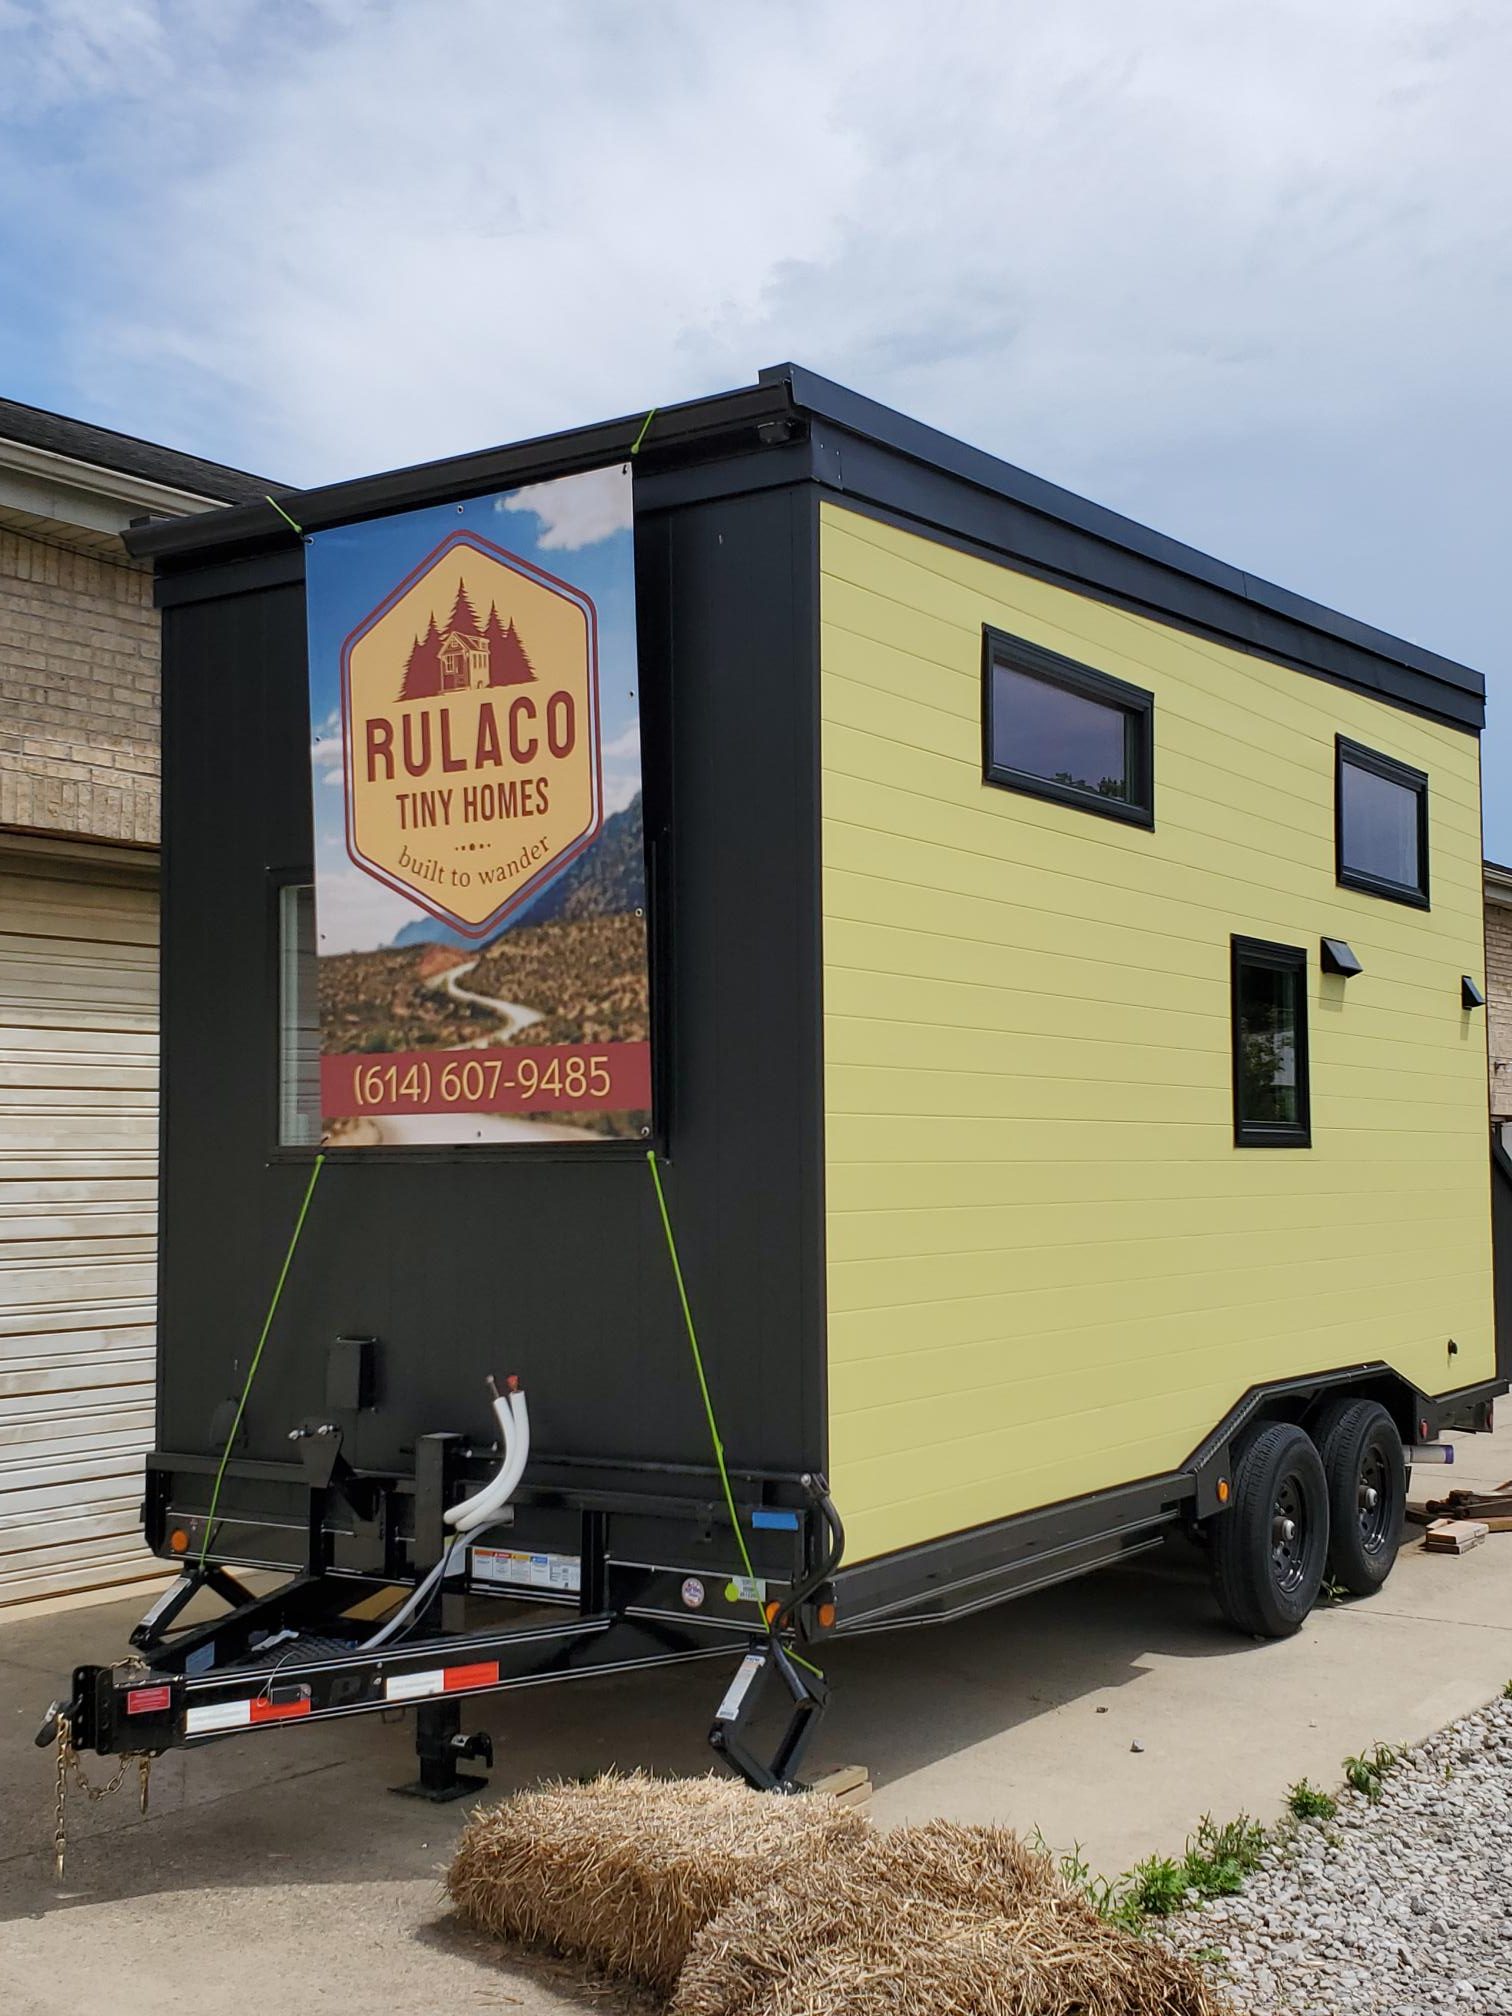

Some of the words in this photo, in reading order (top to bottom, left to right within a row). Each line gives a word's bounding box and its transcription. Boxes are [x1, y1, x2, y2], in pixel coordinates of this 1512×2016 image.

[365, 690, 576, 783] RULACO
[396, 788, 453, 830] TINY
[463, 776, 549, 824] HOMES
[397, 845, 446, 885] built
[450, 866, 471, 888] to
[478, 835, 550, 885] wander
[353, 1061, 432, 1105] (614)
[440, 1056, 612, 1101] 607-9485
